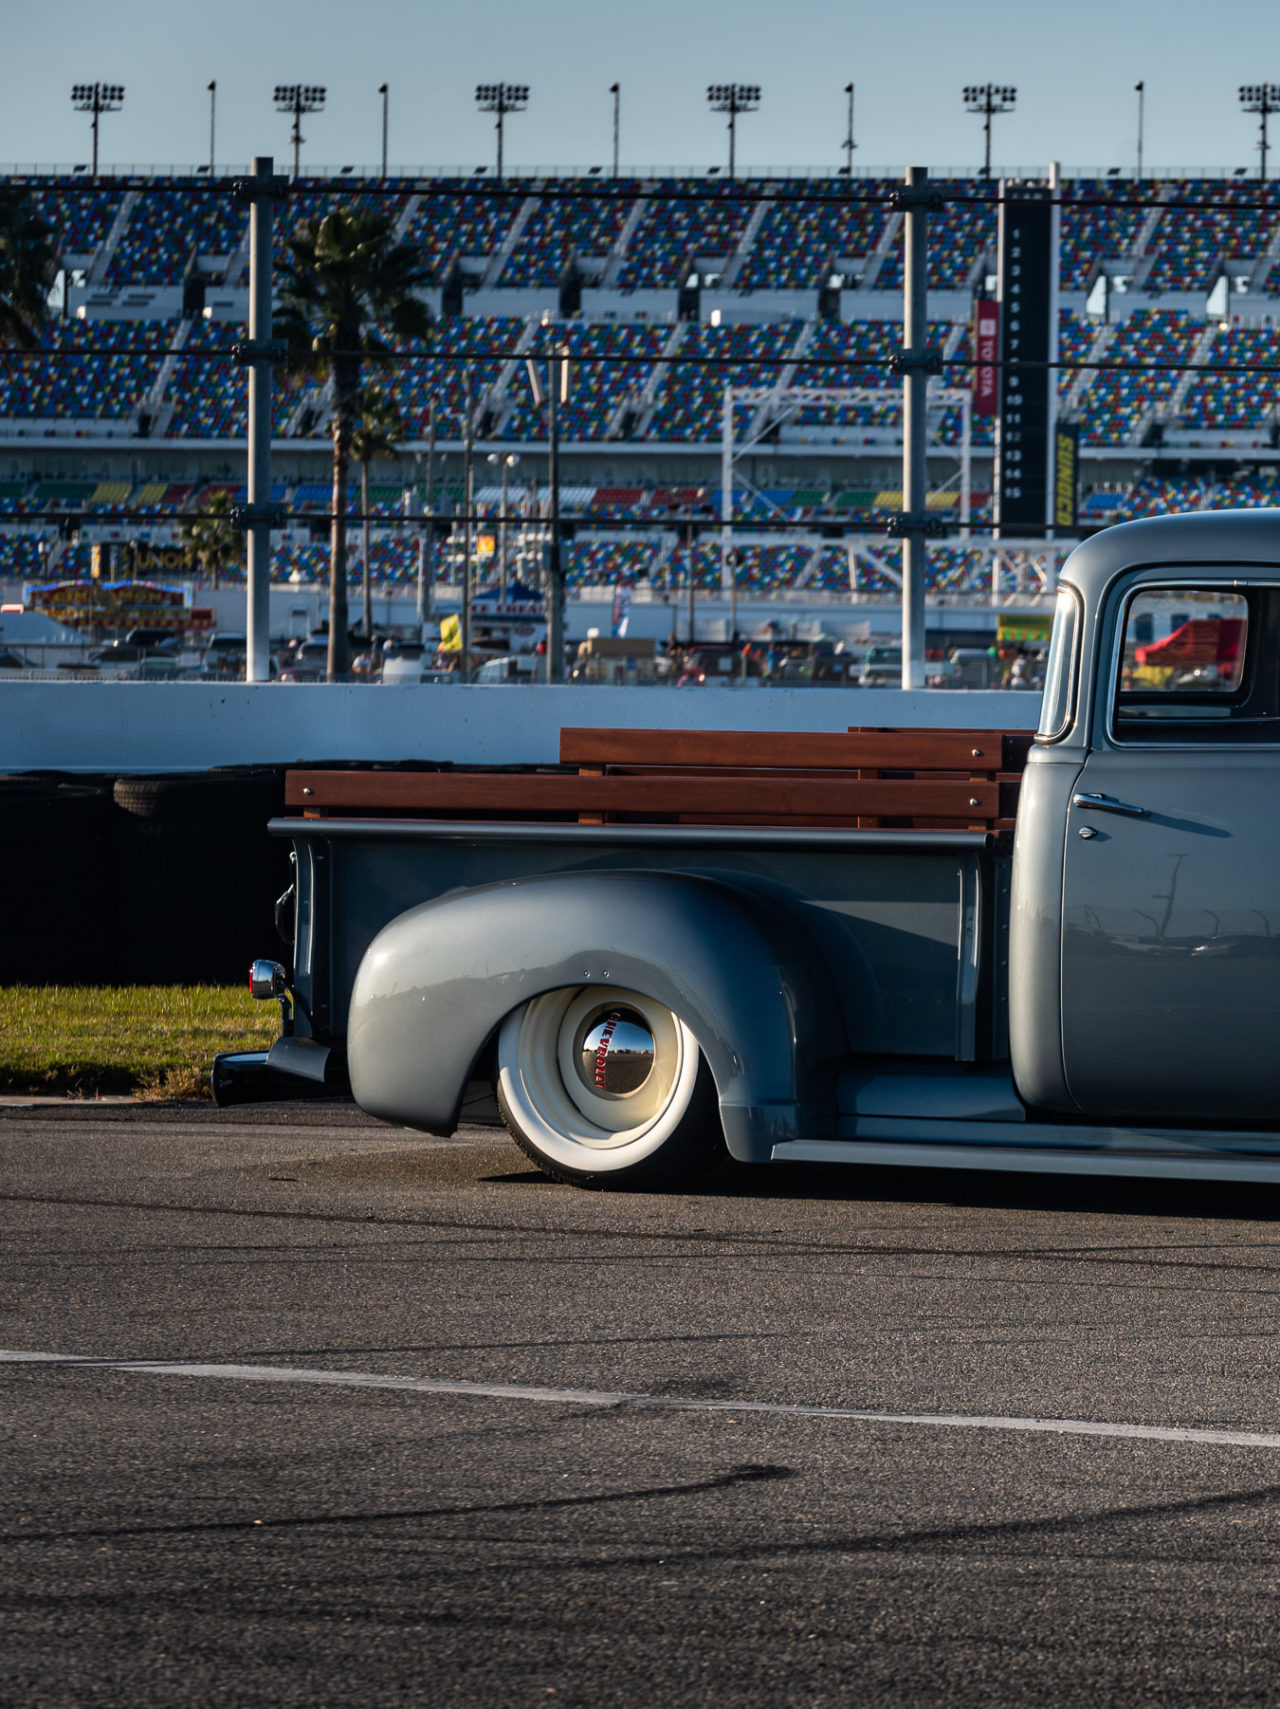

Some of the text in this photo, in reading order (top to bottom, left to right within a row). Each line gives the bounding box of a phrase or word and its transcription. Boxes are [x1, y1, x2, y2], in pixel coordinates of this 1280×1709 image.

[1013, 228, 1020, 239] 1
[1011, 246, 1021, 258] 2
[1011, 264, 1021, 277] 3
[1010, 283, 1020, 295] 4
[1009, 338, 1019, 350] 7
[981, 340, 994, 397] TOOTA
[1008, 375, 1019, 388] 9
[1006, 394, 1022, 406] 10
[1006, 413, 1021, 424] 11
[1056, 433, 1074, 526] SUNOCO
[595, 1012, 621, 1089] CHEVROLET
